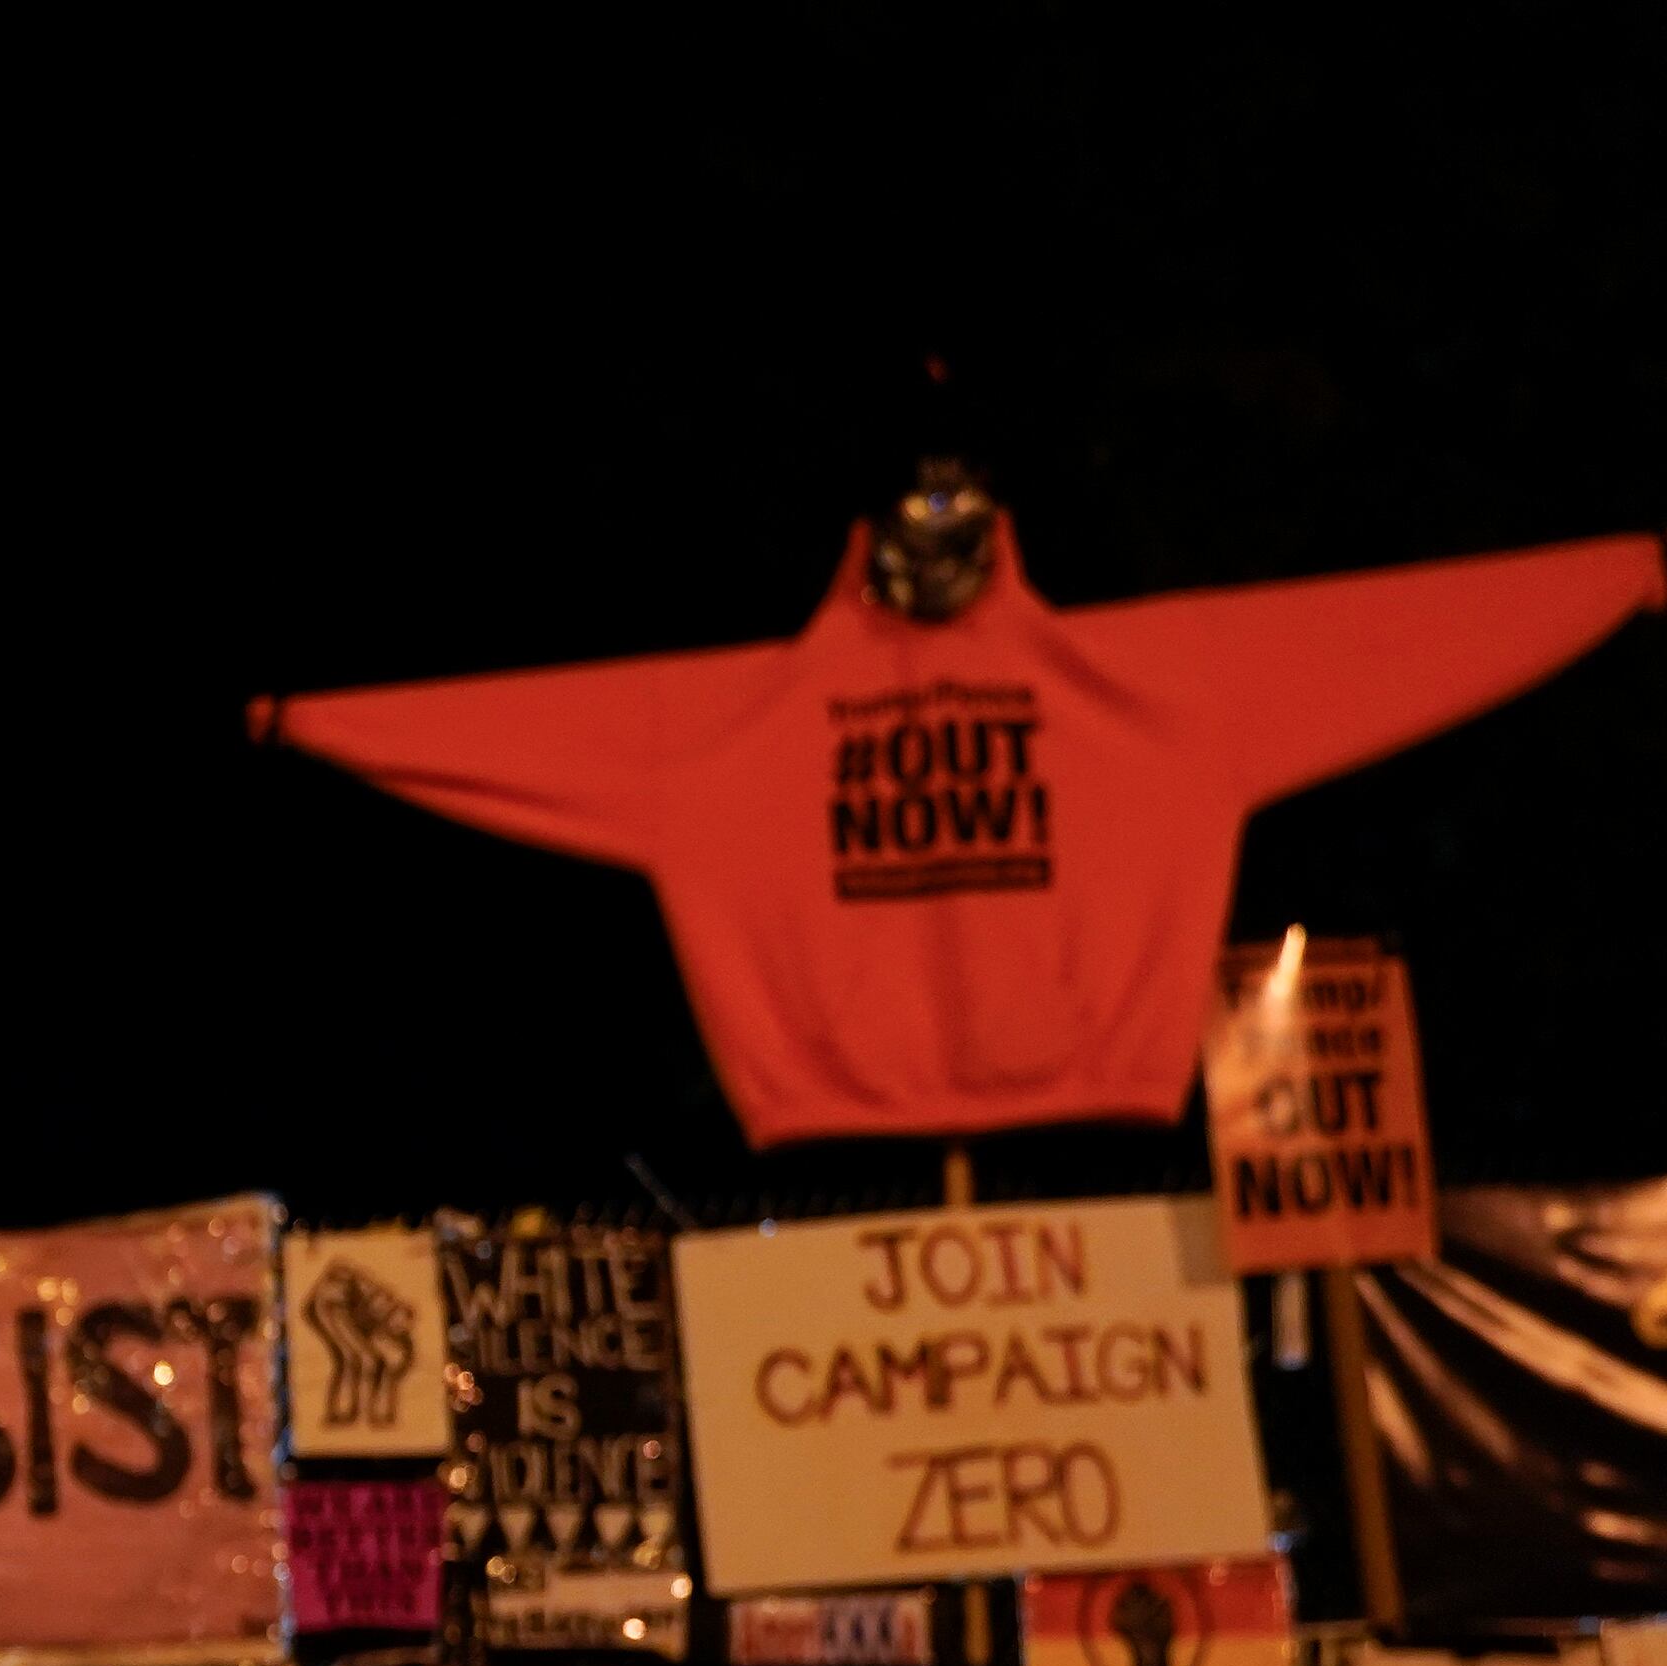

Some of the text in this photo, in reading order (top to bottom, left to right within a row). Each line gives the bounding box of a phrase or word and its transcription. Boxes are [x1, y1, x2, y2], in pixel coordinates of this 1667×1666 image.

[836, 717, 1040, 785] #OUT
[833, 785, 1049, 854] NOW!
[1253, 1070, 1381, 1137] OUT
[1237, 1146, 1417, 1220] NOW!
[861, 1219, 1087, 1310] JOIN
[517, 1374, 582, 1440] IS
[757, 1319, 1209, 1427] CAMPAIGN
[885, 1440, 1120, 1552] ZERO
